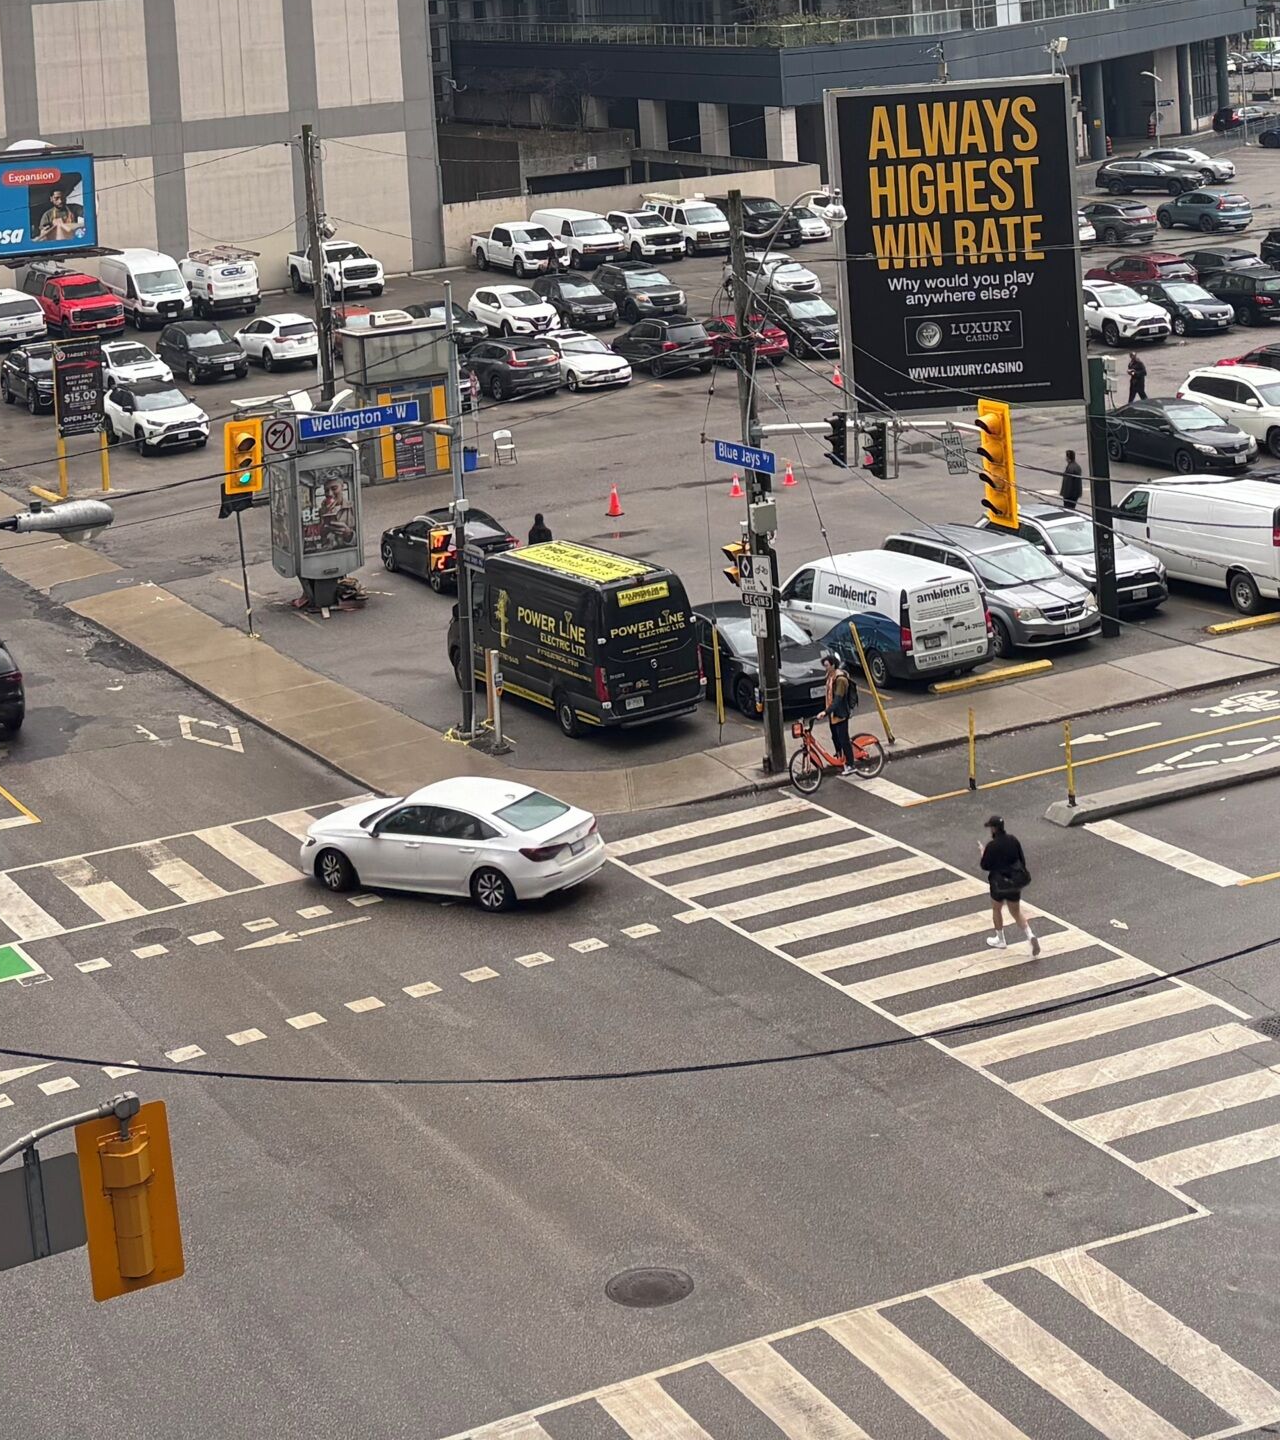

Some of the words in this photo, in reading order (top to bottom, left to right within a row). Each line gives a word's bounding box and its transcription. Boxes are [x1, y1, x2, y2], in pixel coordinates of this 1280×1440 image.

[869, 96, 1039, 160] ALWAYS
[8, 171, 54, 183] Expansion
[869, 156, 1040, 218] HIGHEST
[872, 221, 943, 270] WIN
[954, 215, 1045, 265] RATE
[888, 277, 920, 293] Why
[925, 273, 969, 289] would
[972, 274, 999, 289] you
[1004, 270, 1035, 286] play
[906, 289, 976, 307] anywhere
[980, 285, 1018, 300] else?
[950, 320, 1013, 335] LUXURY
[966, 333, 999, 342] CASINO
[908, 360, 1024, 379] WWW.LUXURY.CASINO
[63, 390, 97, 404] $15.00
[311, 410, 382, 432] Wellington
[395, 404, 407, 419] W
[718, 442, 738, 461] Blue
[741, 449, 761, 468] Jays
[517, 606, 556, 633] POWER
[559, 612, 586, 645] LINE
[610, 620, 655, 638] POWER
[658, 611, 686, 627] LINE
[638, 624, 671, 639] ELECTRIC
[540, 631, 571, 652] ELECTRIC
